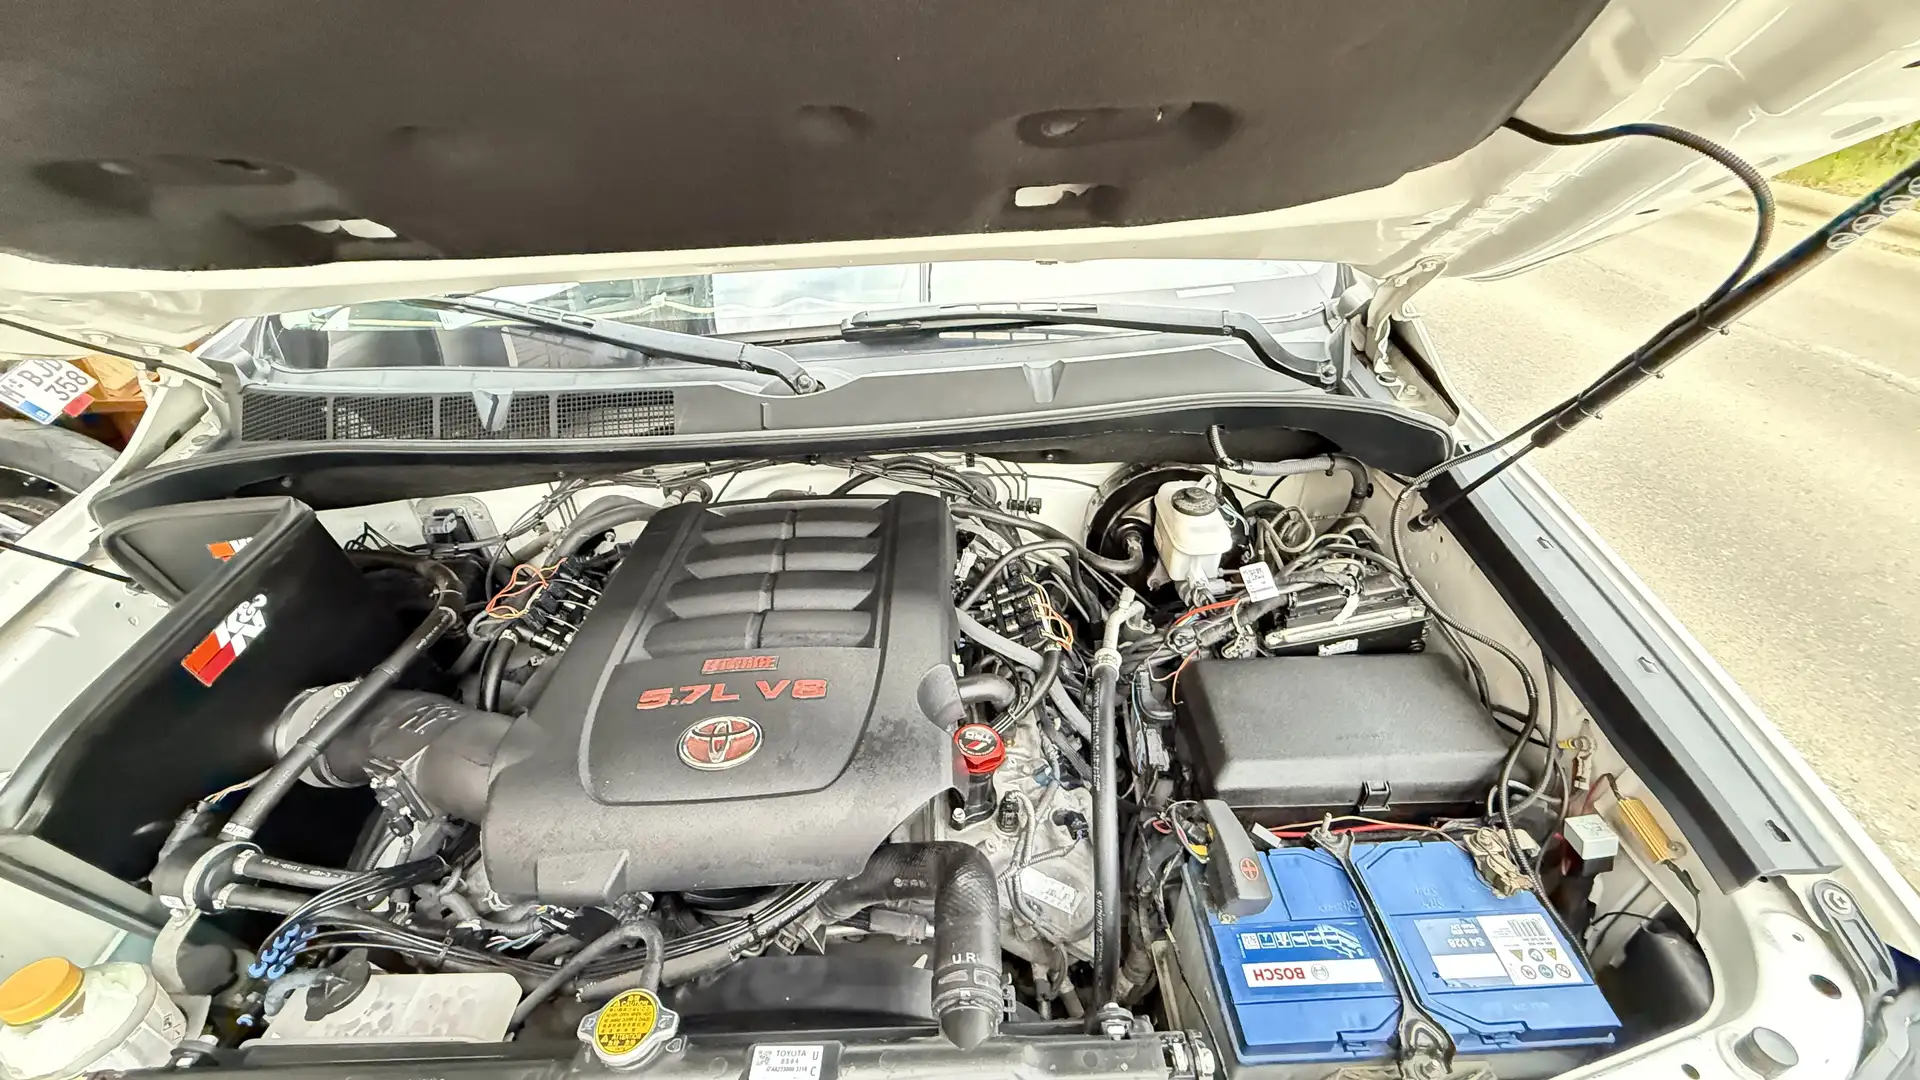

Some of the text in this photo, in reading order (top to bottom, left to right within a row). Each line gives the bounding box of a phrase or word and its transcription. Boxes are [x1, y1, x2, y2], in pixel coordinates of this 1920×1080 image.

[44, 370, 89, 401] 358
[636, 679, 828, 710] 5.7L V8
[1252, 967, 1306, 981] BOSCH
